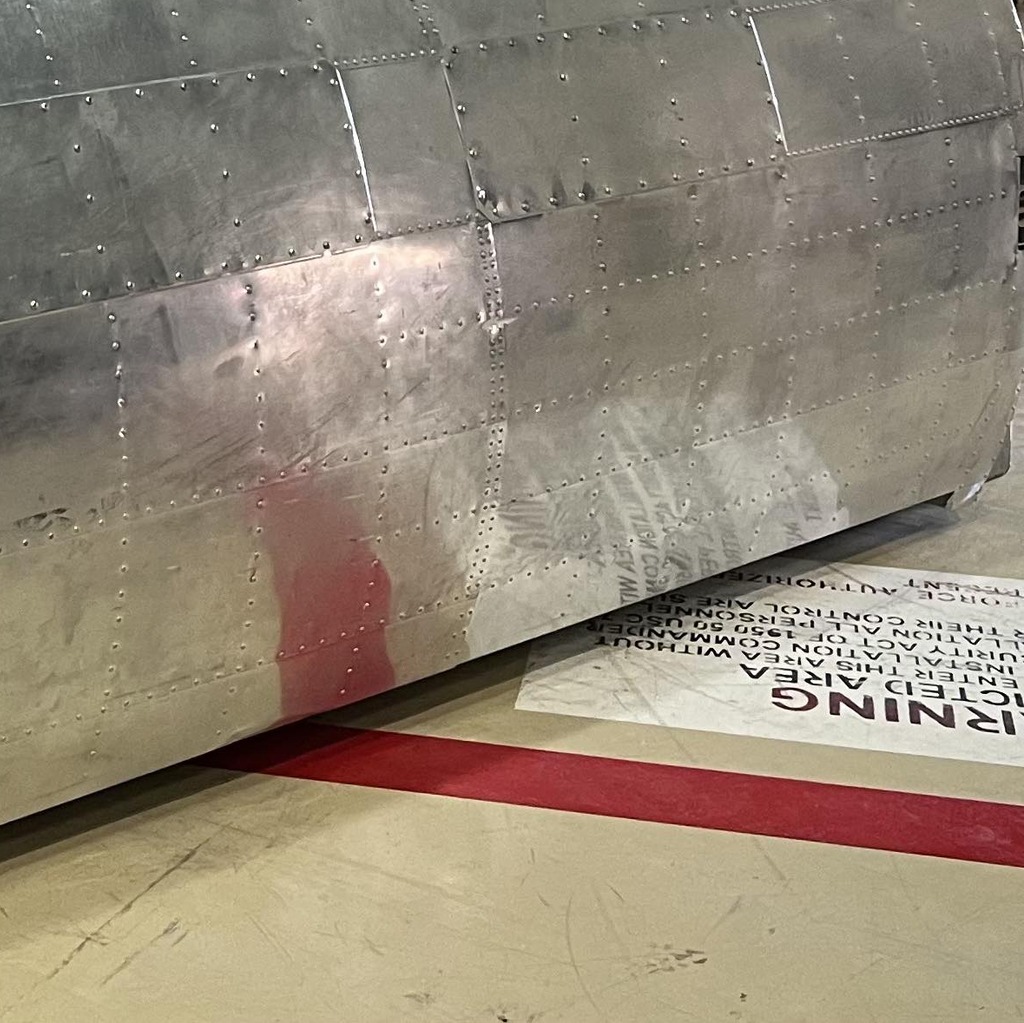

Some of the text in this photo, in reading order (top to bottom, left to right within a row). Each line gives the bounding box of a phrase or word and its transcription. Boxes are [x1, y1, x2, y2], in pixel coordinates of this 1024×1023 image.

[698, 597, 754, 610] ARE
[626, 613, 682, 628] USC
[764, 603, 905, 626] CONTROL
[641, 602, 1024, 650] LLATION ALL PERSONNEL
[693, 620, 723, 632] 50
[734, 624, 795, 640] 1950
[916, 619, 1004, 636] THEIR
[808, 632, 846, 644] OF
[861, 637, 917, 652] ACT
[586, 622, 1013, 675] INSTALLATION COMMANDER
[929, 645, 1024, 664] URITY
[594, 636, 1017, 689] ENTER THIS AREA WITHOUT
[739, 664, 1024, 708] ICTED AREA
[771, 687, 1024, 736] RNING
